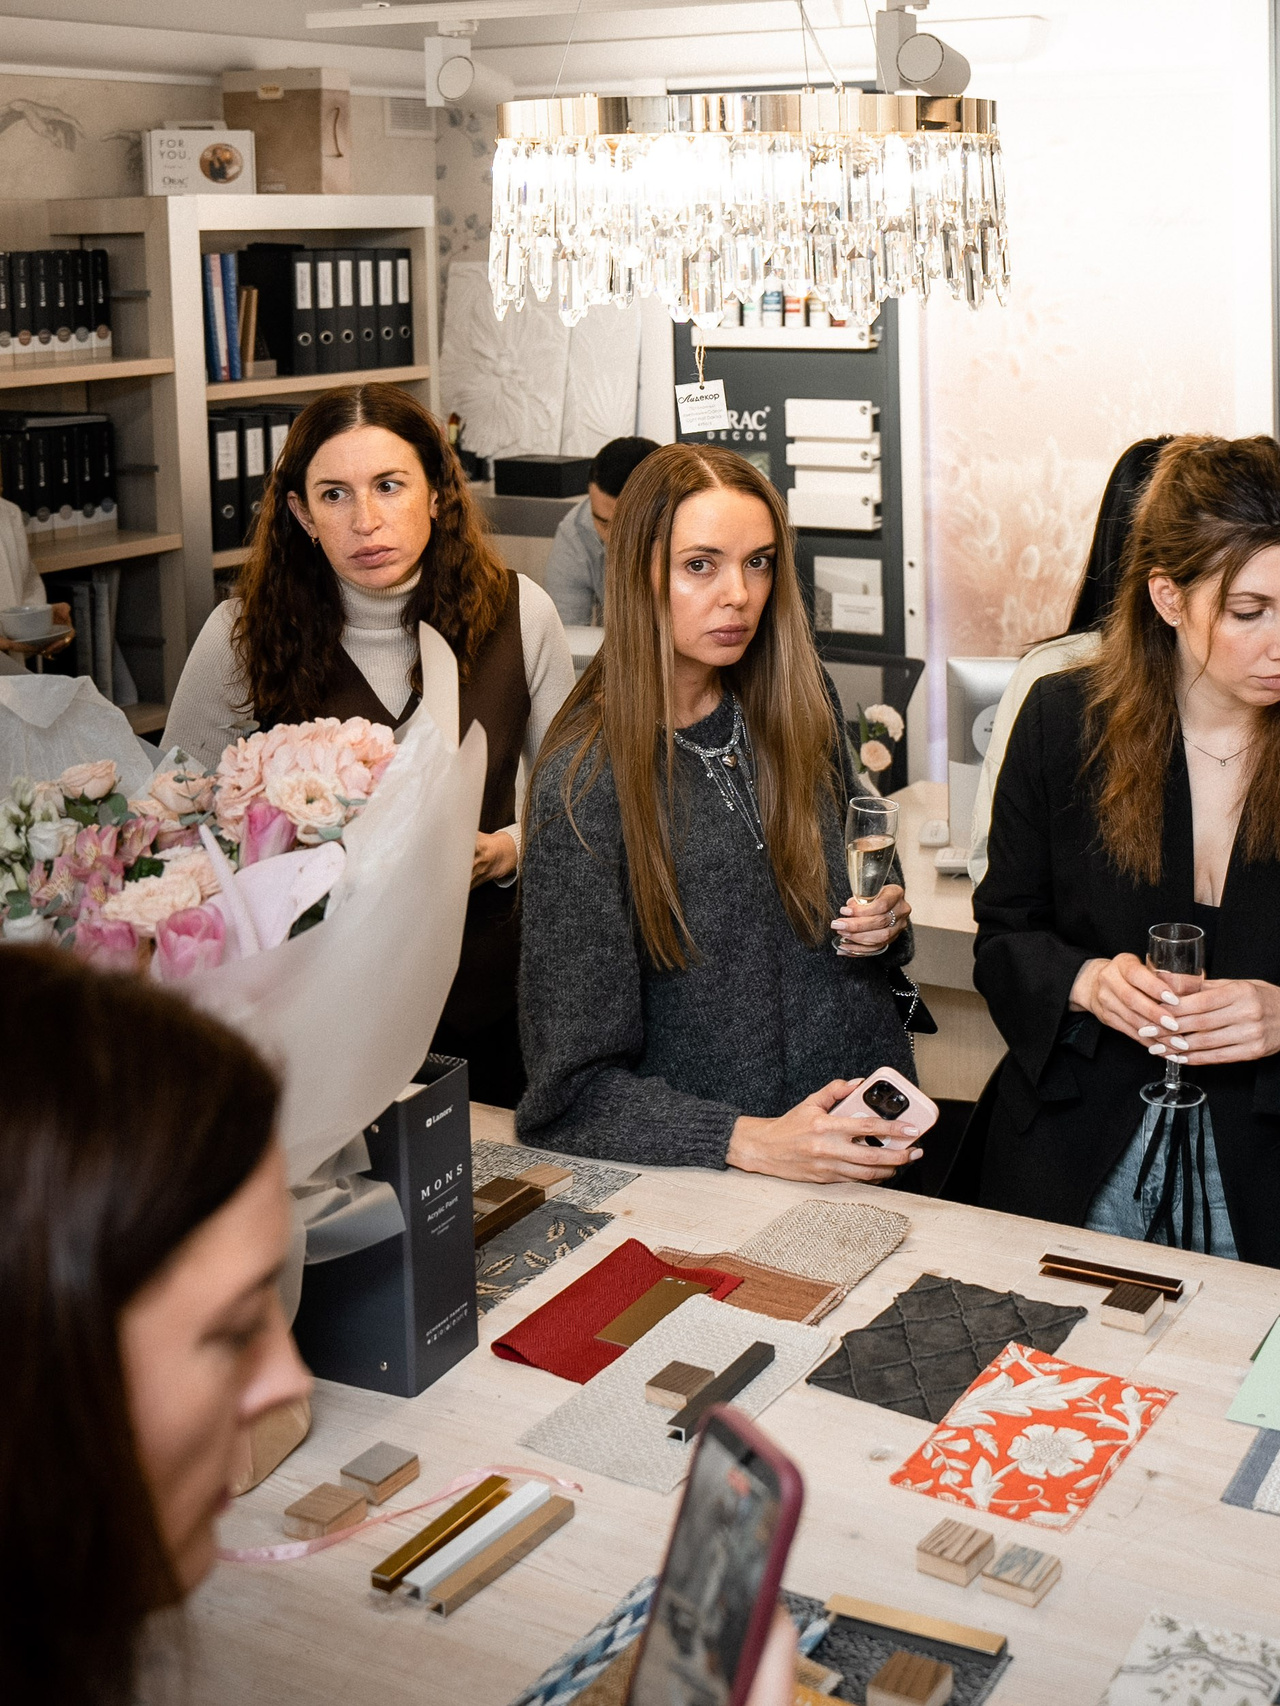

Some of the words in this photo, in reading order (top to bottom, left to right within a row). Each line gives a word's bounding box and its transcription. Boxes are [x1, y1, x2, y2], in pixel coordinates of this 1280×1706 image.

[160, 139, 184, 148] FOR
[678, 393, 720, 404] Лидекор
[727, 409, 767, 431] RAC
[707, 430, 767, 441] DECOR
[432, 1106, 453, 1124] Lanors
[421, 1163, 463, 1201] MONS
[427, 1205, 445, 1222] Acrylic
[446, 1195, 459, 1210] Paint
